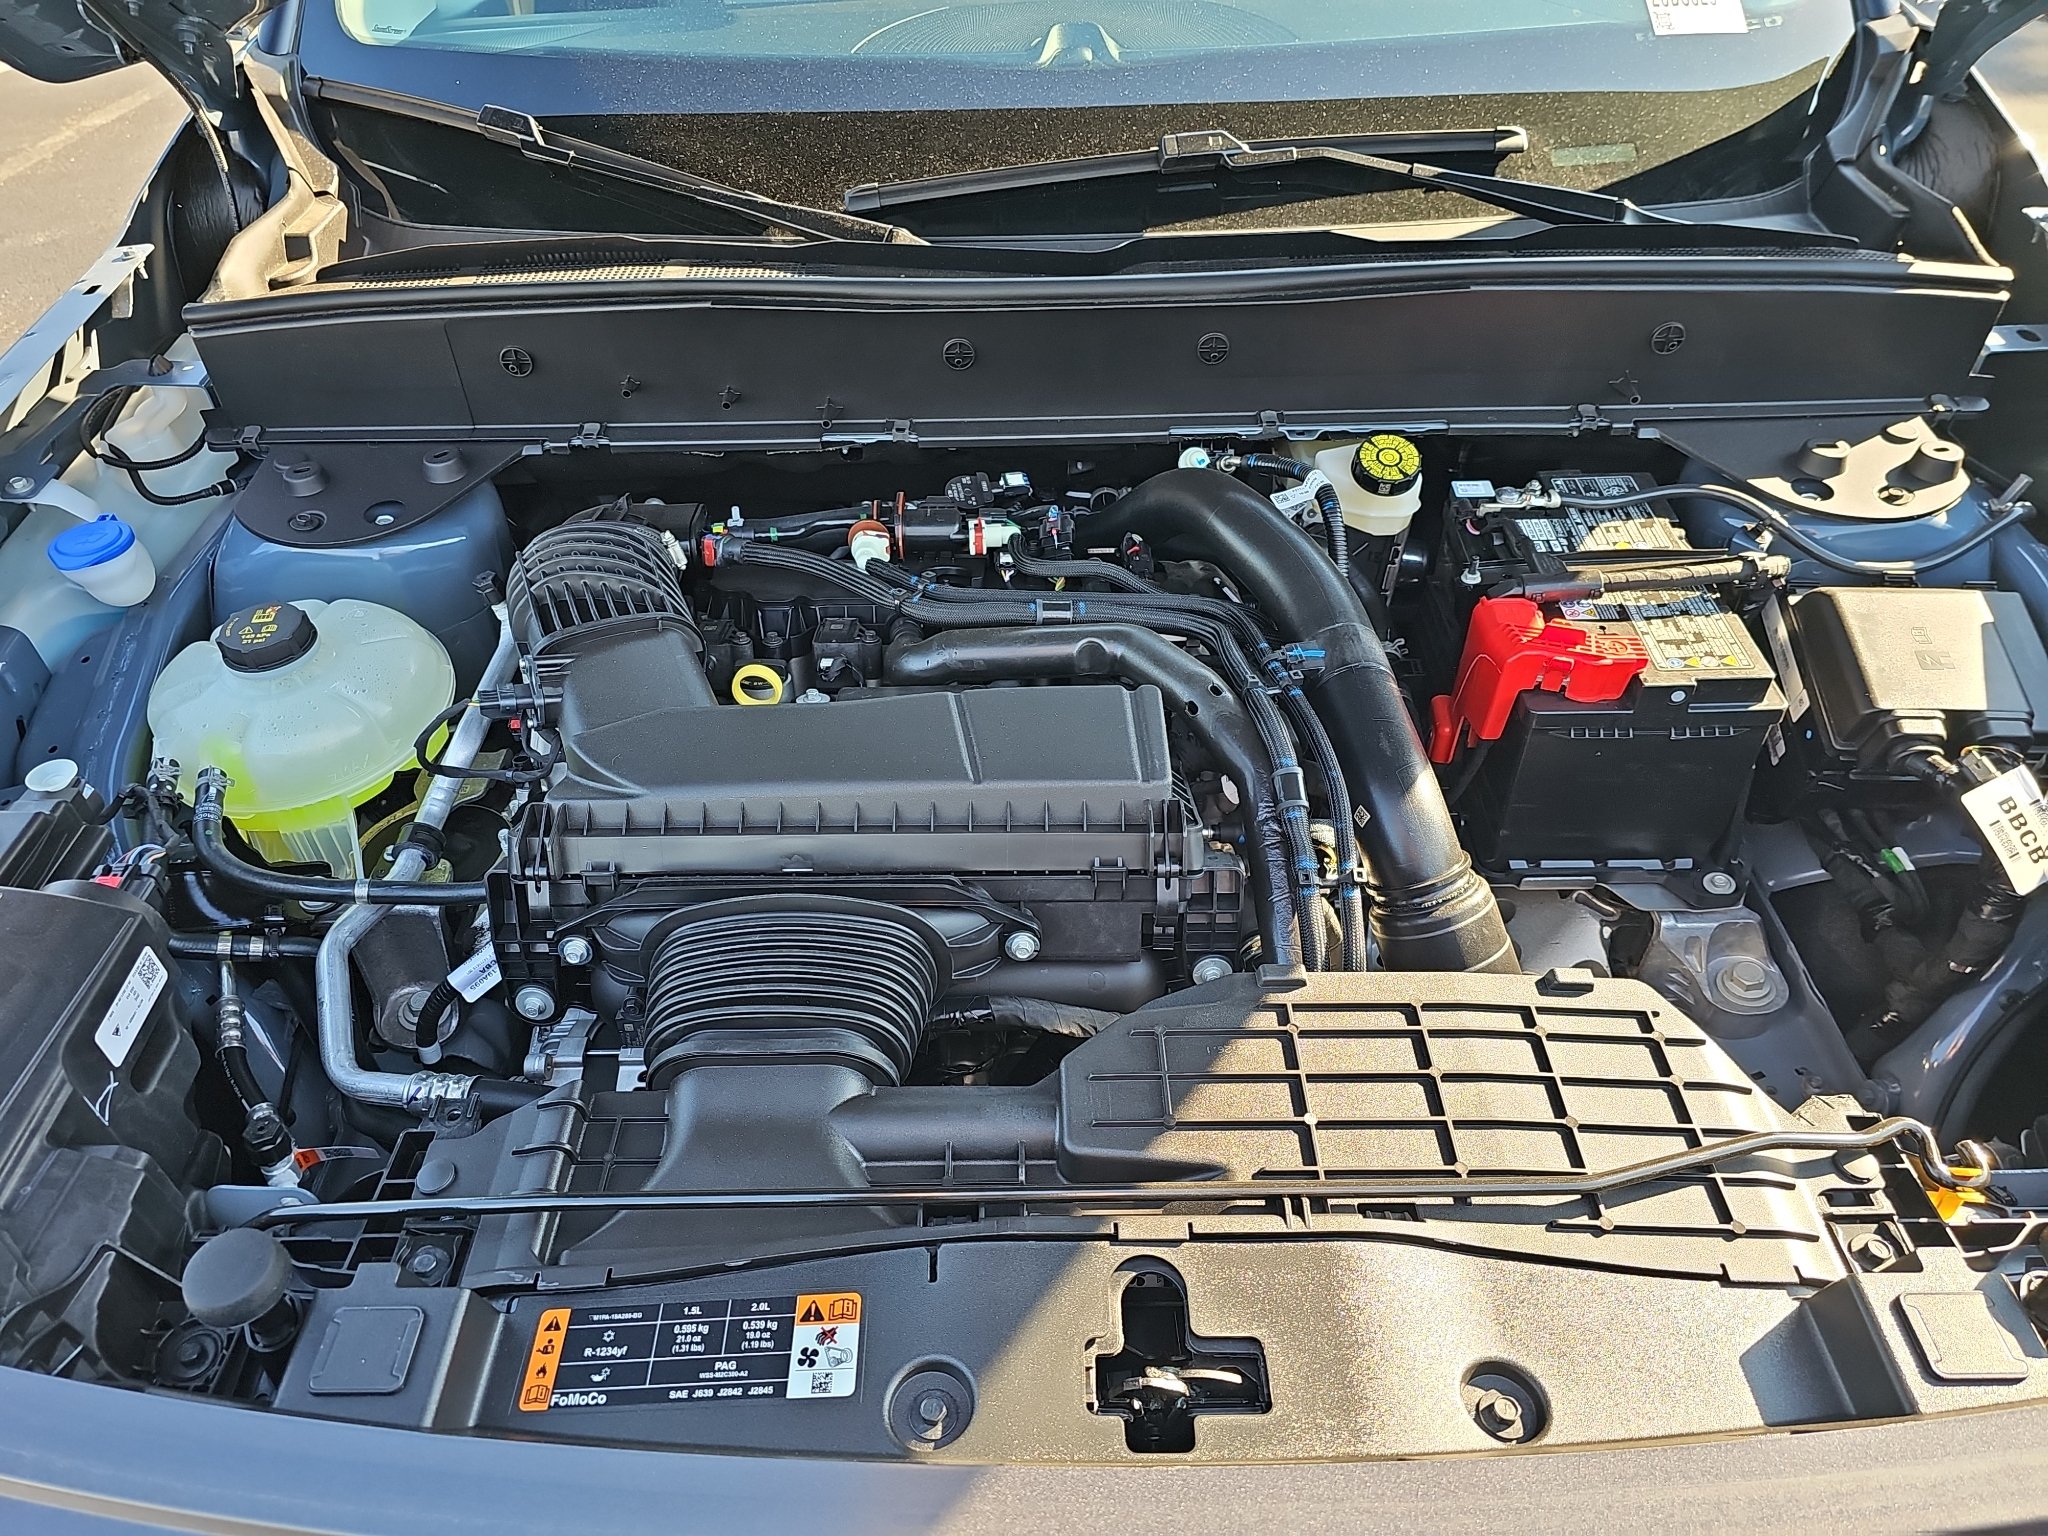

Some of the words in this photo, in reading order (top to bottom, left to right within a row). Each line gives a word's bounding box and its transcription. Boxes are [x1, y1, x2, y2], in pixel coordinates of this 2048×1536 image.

[683, 1306, 703, 1315] 1.5L
[750, 1302, 771, 1312] 2.0L
[673, 1324, 697, 1334] 0.595
[698, 1323, 709, 1335] kg
[742, 1320, 766, 1330] 0.539
[767, 1319, 778, 1331] kg
[675, 1334, 692, 1343] 21.0
[692, 1334, 702, 1342] oz
[745, 1331, 761, 1339] 19.0
[761, 1331, 771, 1339] oz
[583, 1345, 629, 1358] R-1234yf
[714, 1360, 737, 1370] PAG
[668, 1390, 689, 1399] SAE
[691, 1388, 714, 1398] J639
[716, 1387, 743, 1397] J2842
[747, 1386, 774, 1396] J2845
[550, 1392, 608, 1407] FoMoCo
